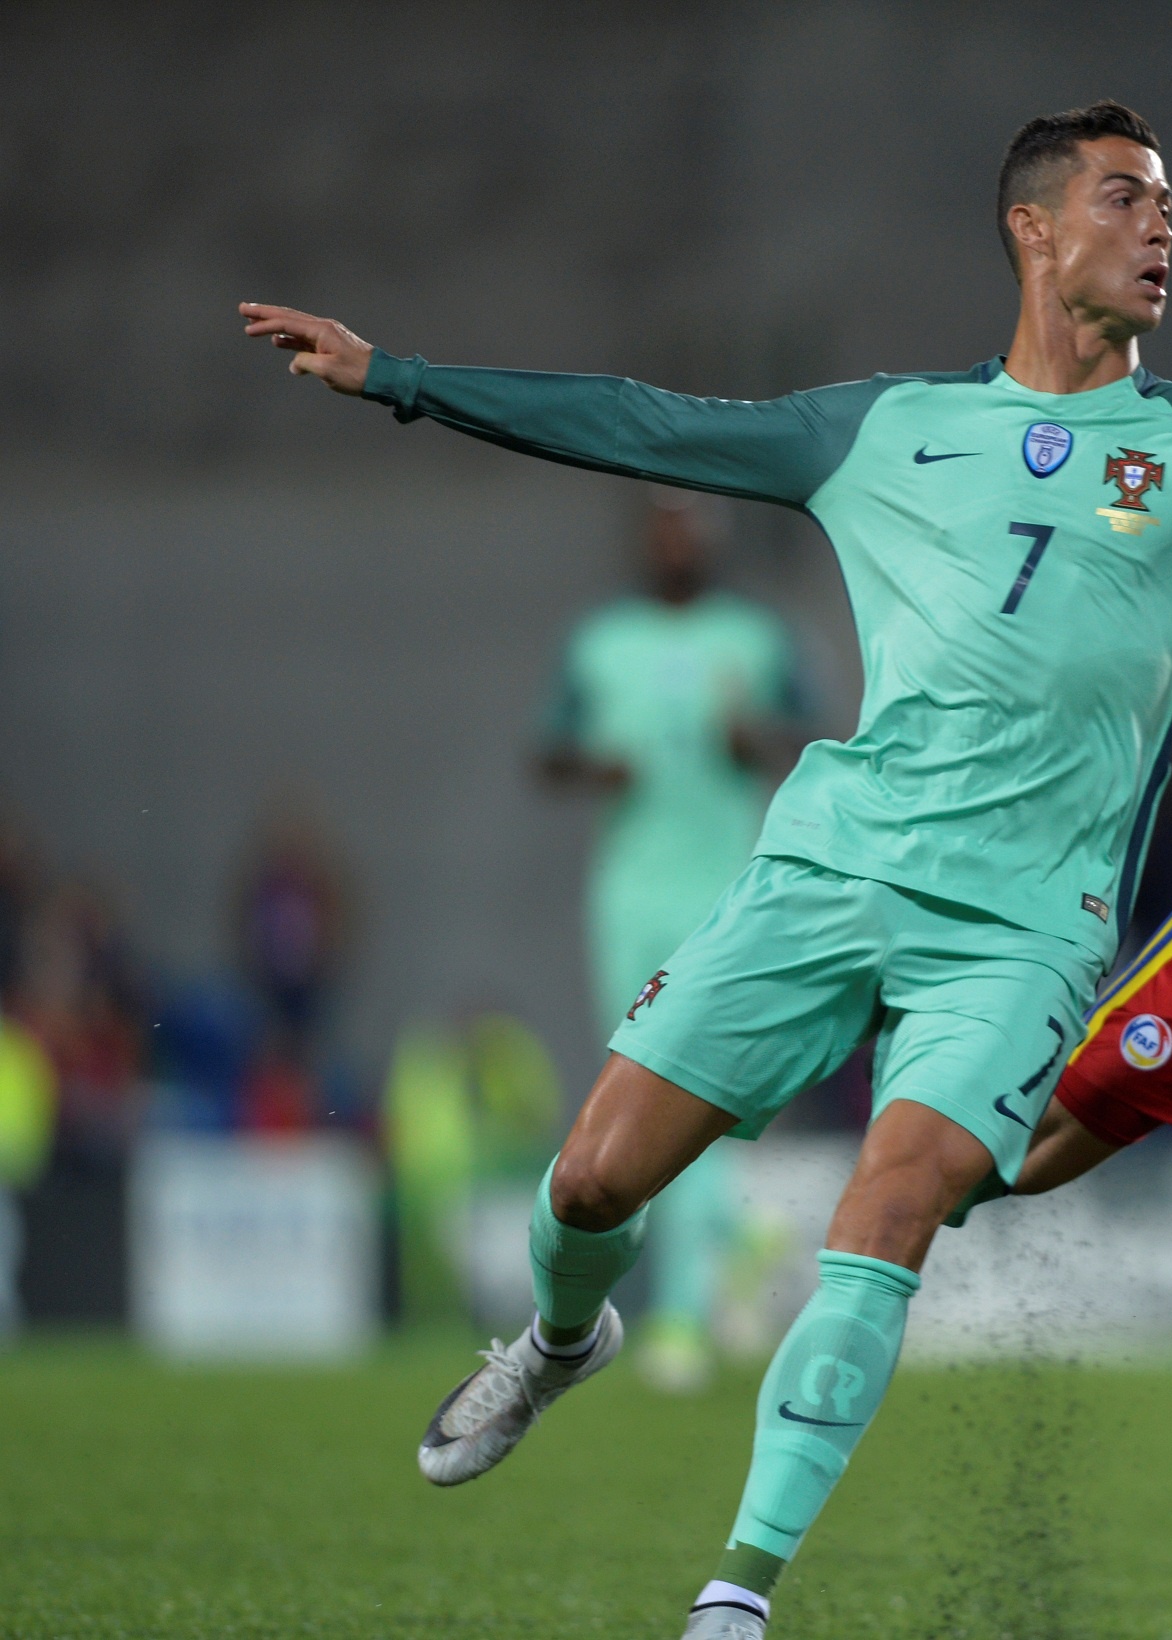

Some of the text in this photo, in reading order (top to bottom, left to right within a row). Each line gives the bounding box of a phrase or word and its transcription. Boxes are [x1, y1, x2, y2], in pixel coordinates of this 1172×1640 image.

[1000, 521, 1056, 615] 7
[1018, 1014, 1065, 1097] 7
[1132, 1031, 1158, 1051] FAF
